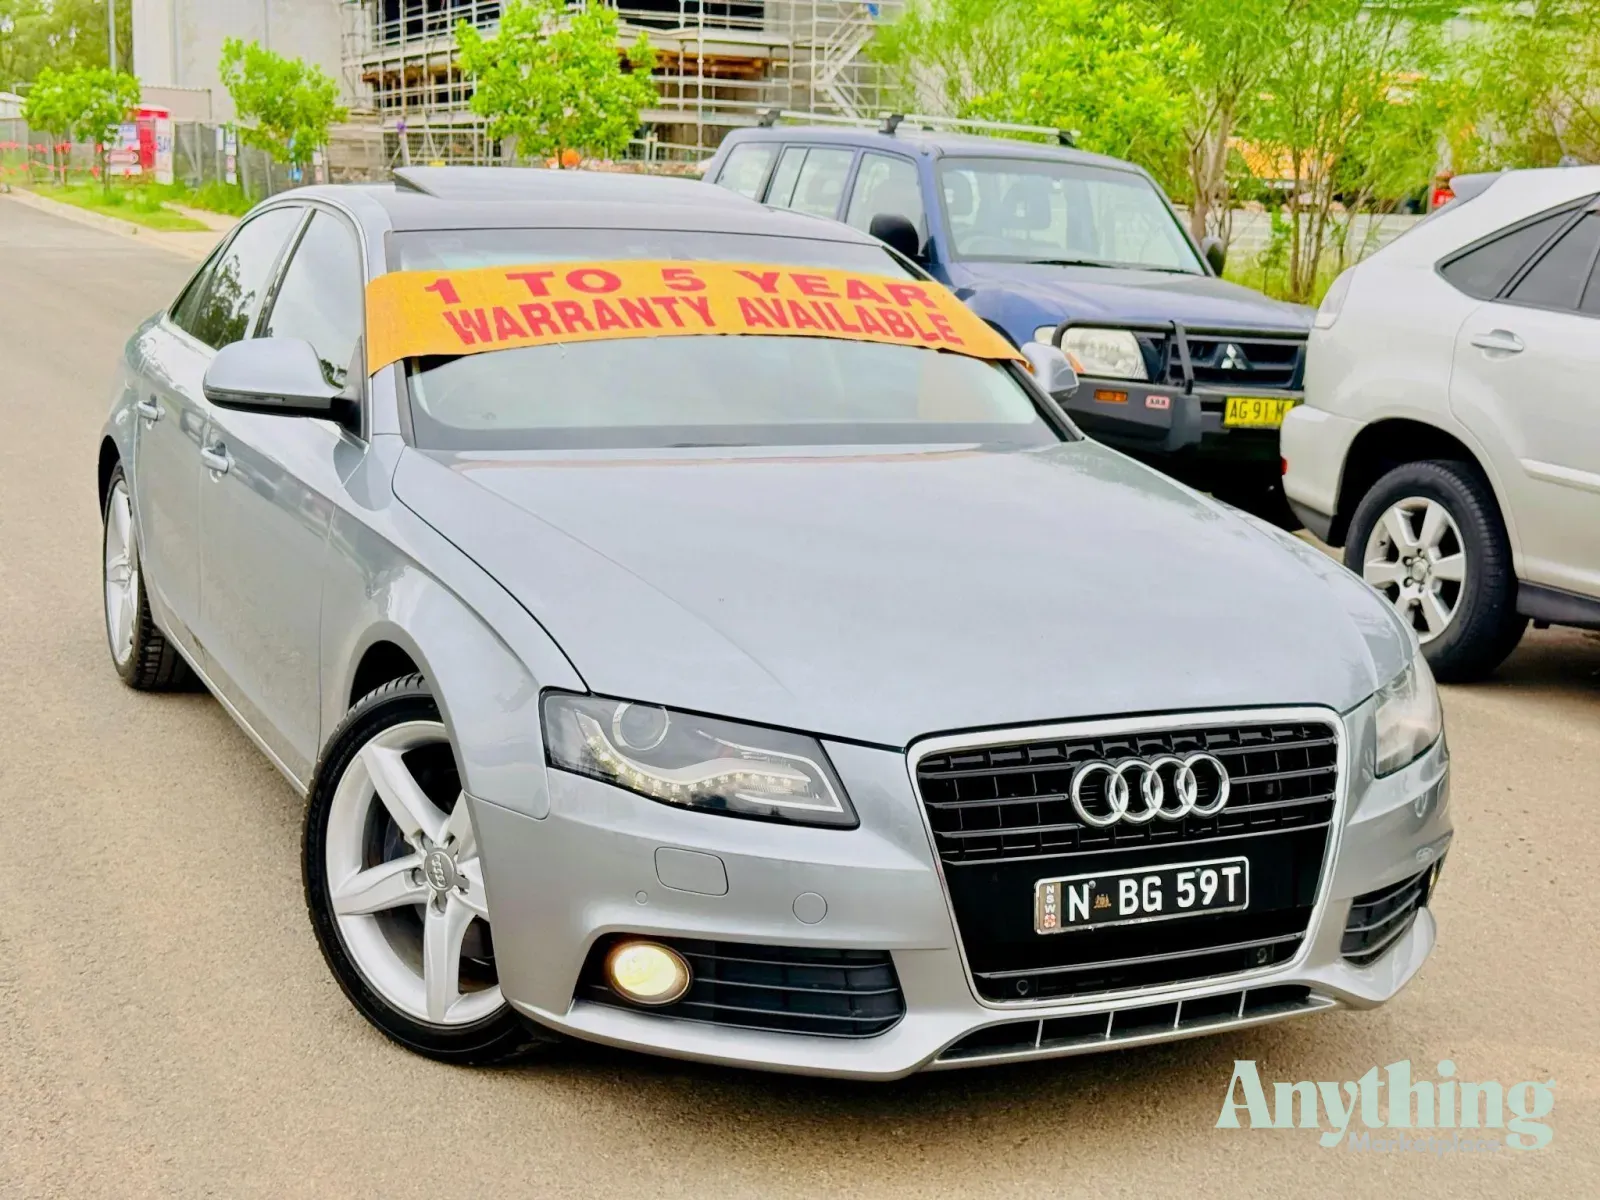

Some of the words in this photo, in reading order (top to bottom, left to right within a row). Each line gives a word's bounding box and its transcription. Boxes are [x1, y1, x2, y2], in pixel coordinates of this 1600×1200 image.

[424, 278, 462, 304] 1
[504, 268, 622, 297] TO
[661, 268, 707, 292] 5
[732, 270, 940, 308] YEAR
[442, 295, 717, 346] WARRANTY
[736, 296, 966, 346] AVAILABLE
[1229, 400, 1248, 419] AG
[1044, 884, 1056, 914] NSW
[1068, 884, 1091, 922] N
[1118, 875, 1163, 916] BG
[1176, 866, 1242, 909] 59T
